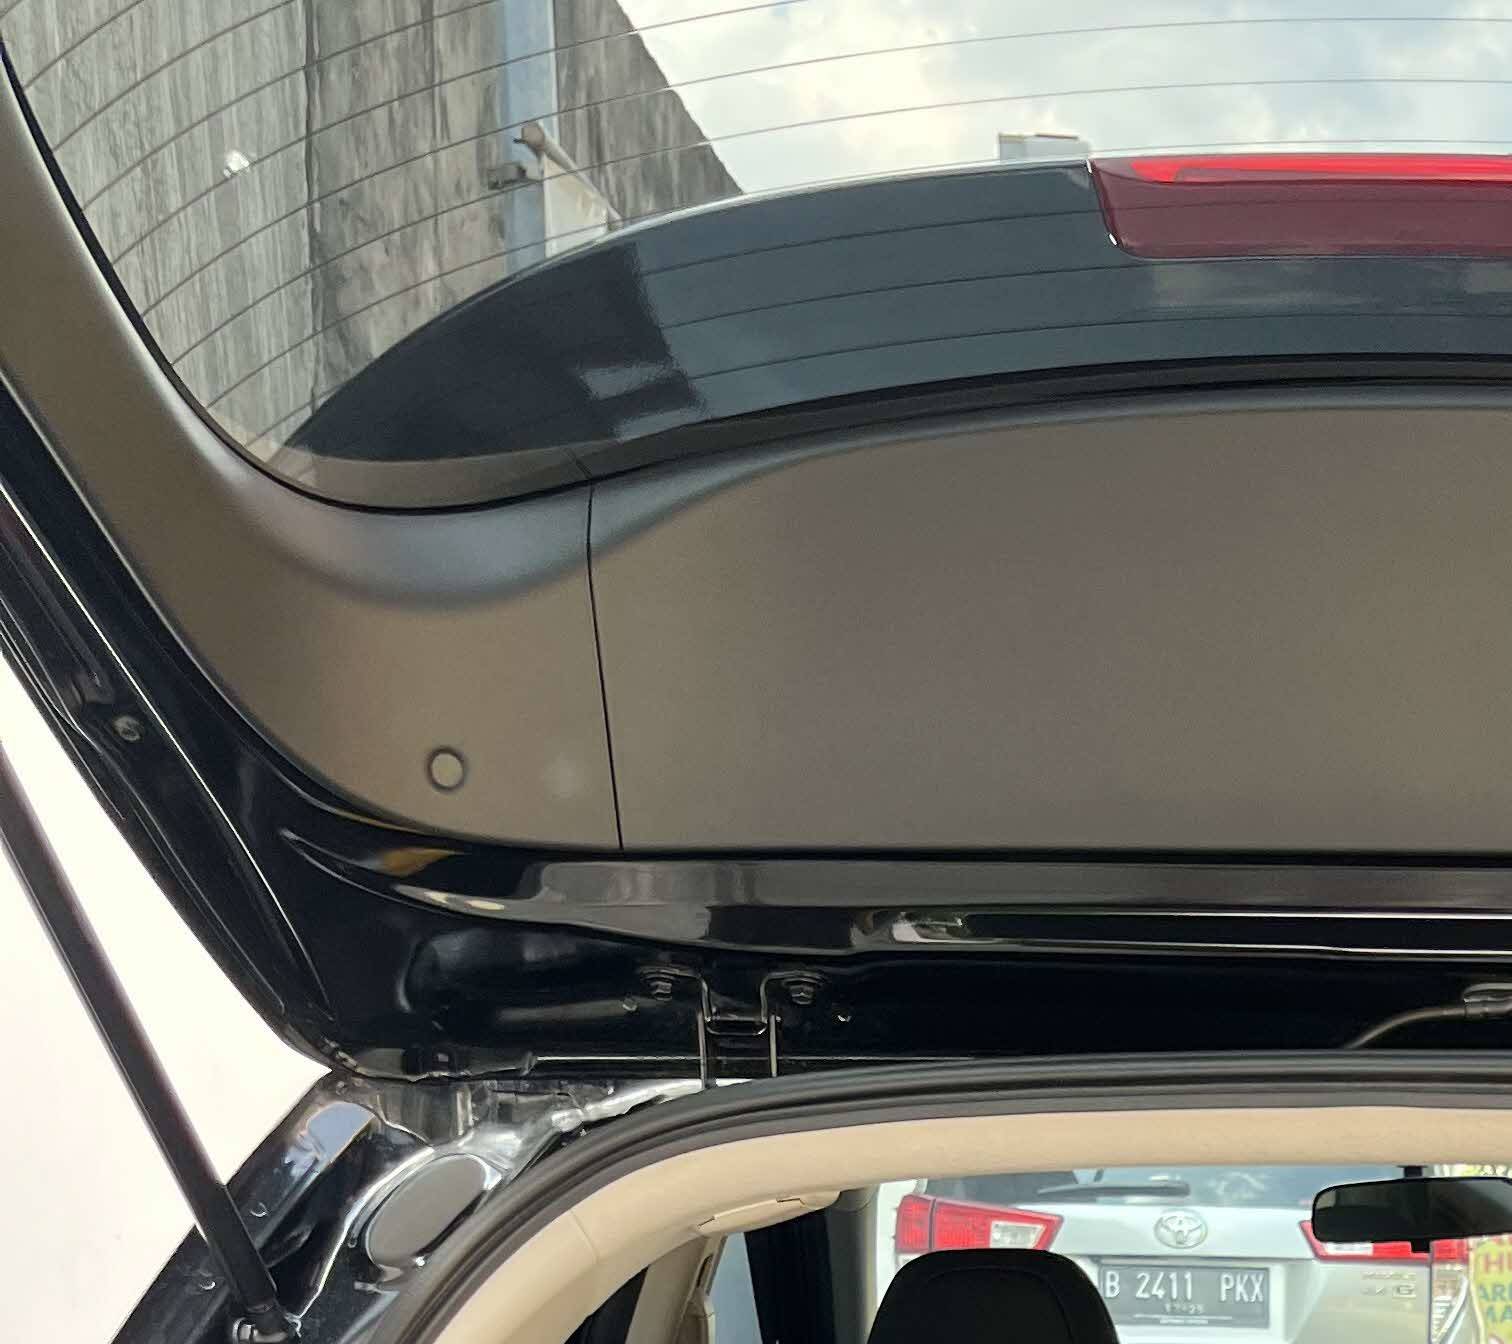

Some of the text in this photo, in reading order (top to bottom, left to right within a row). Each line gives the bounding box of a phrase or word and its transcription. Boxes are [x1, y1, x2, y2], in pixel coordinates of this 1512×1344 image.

[1105, 1270, 1264, 1302] B 2411 PKX
